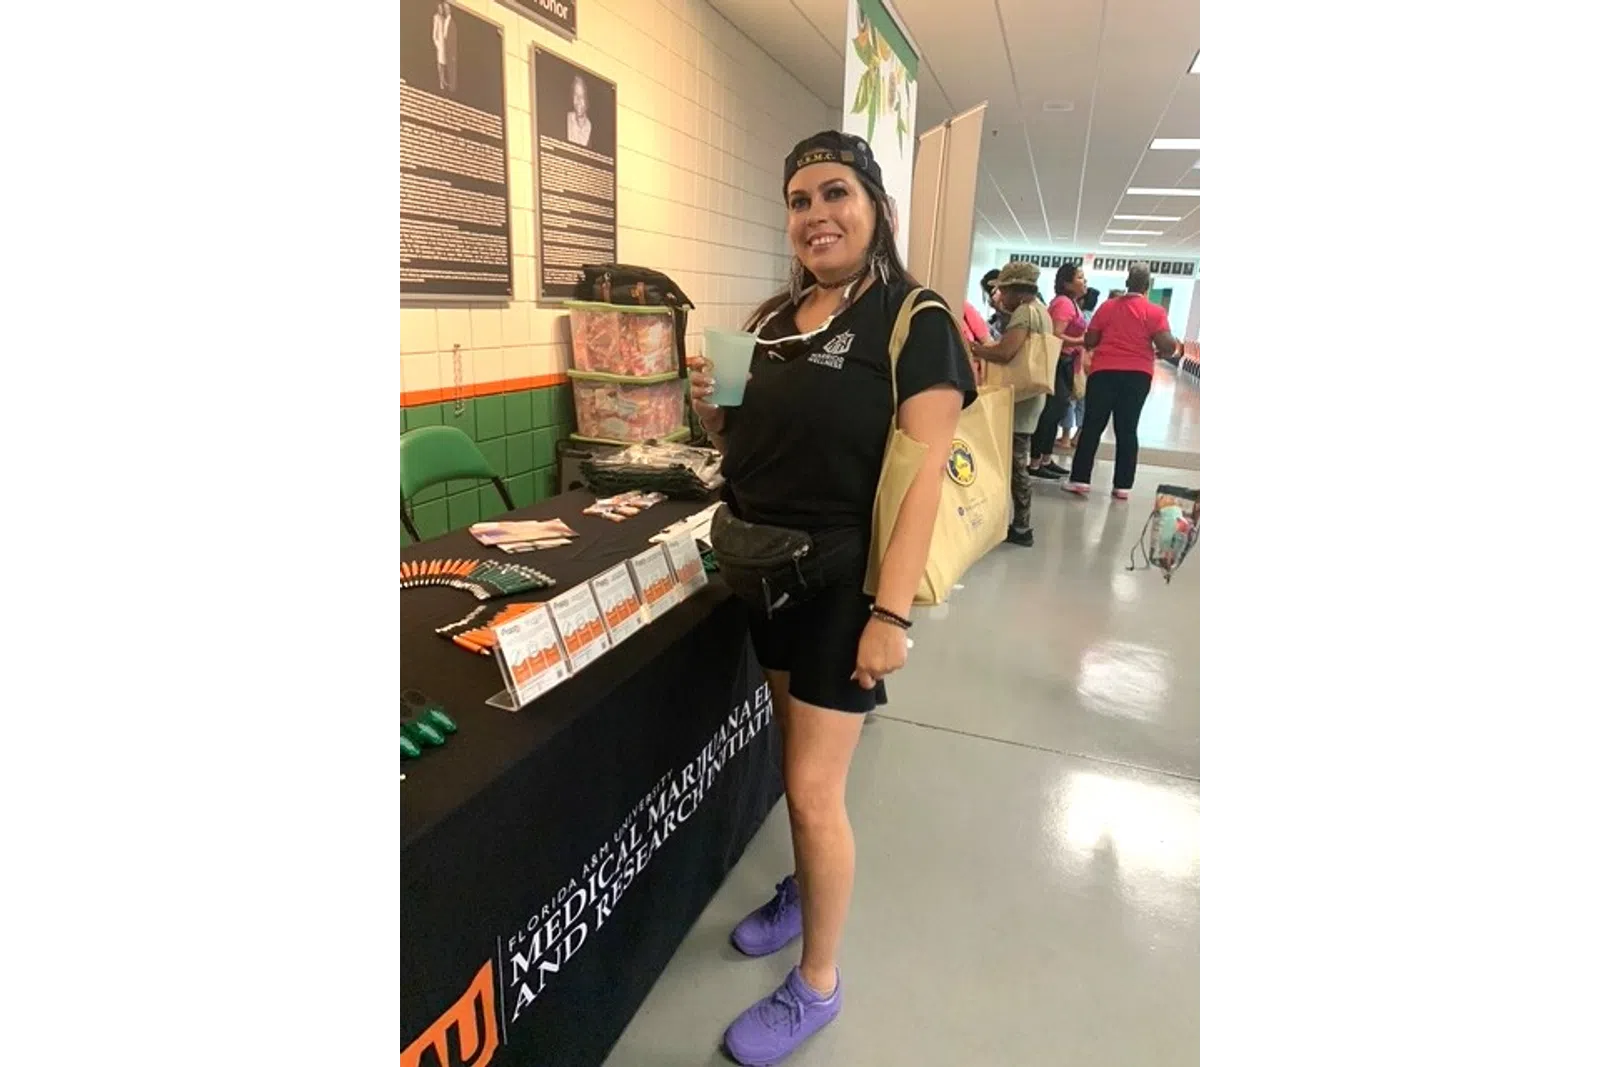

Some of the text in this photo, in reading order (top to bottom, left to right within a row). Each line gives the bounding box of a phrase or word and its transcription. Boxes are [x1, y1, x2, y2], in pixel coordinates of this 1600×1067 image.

[533, 0, 568, 19] onor
[508, 768, 673, 952] FLORIDA A&M UNIVERSITY
[510, 823, 643, 987] MEDICAL
[647, 700, 751, 833] MARIJUANA
[511, 922, 588, 1023] AND
[596, 776, 703, 931] RESEARCH
